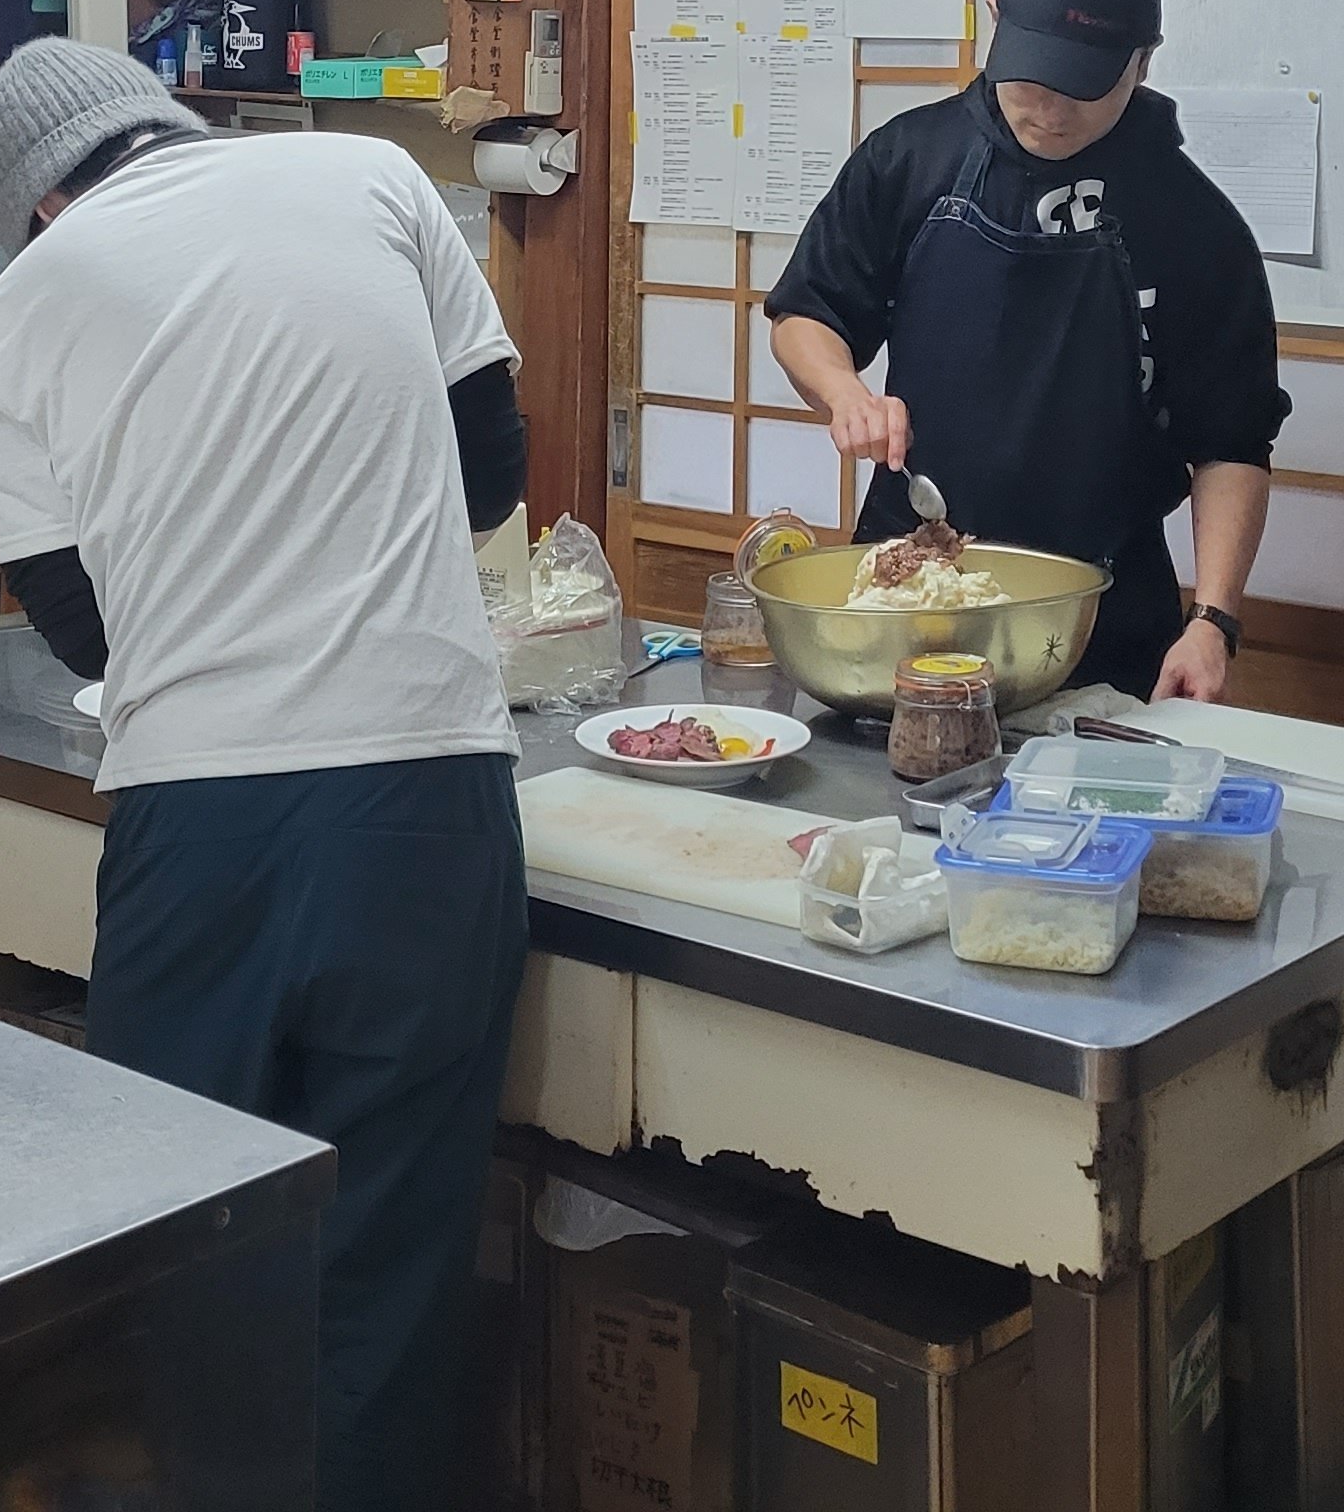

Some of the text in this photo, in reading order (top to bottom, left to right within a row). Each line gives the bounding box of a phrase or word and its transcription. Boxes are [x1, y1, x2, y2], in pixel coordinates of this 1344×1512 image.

[231, 35, 261, 47] CHUMS
[787, 1386, 865, 1439] ペンネ
